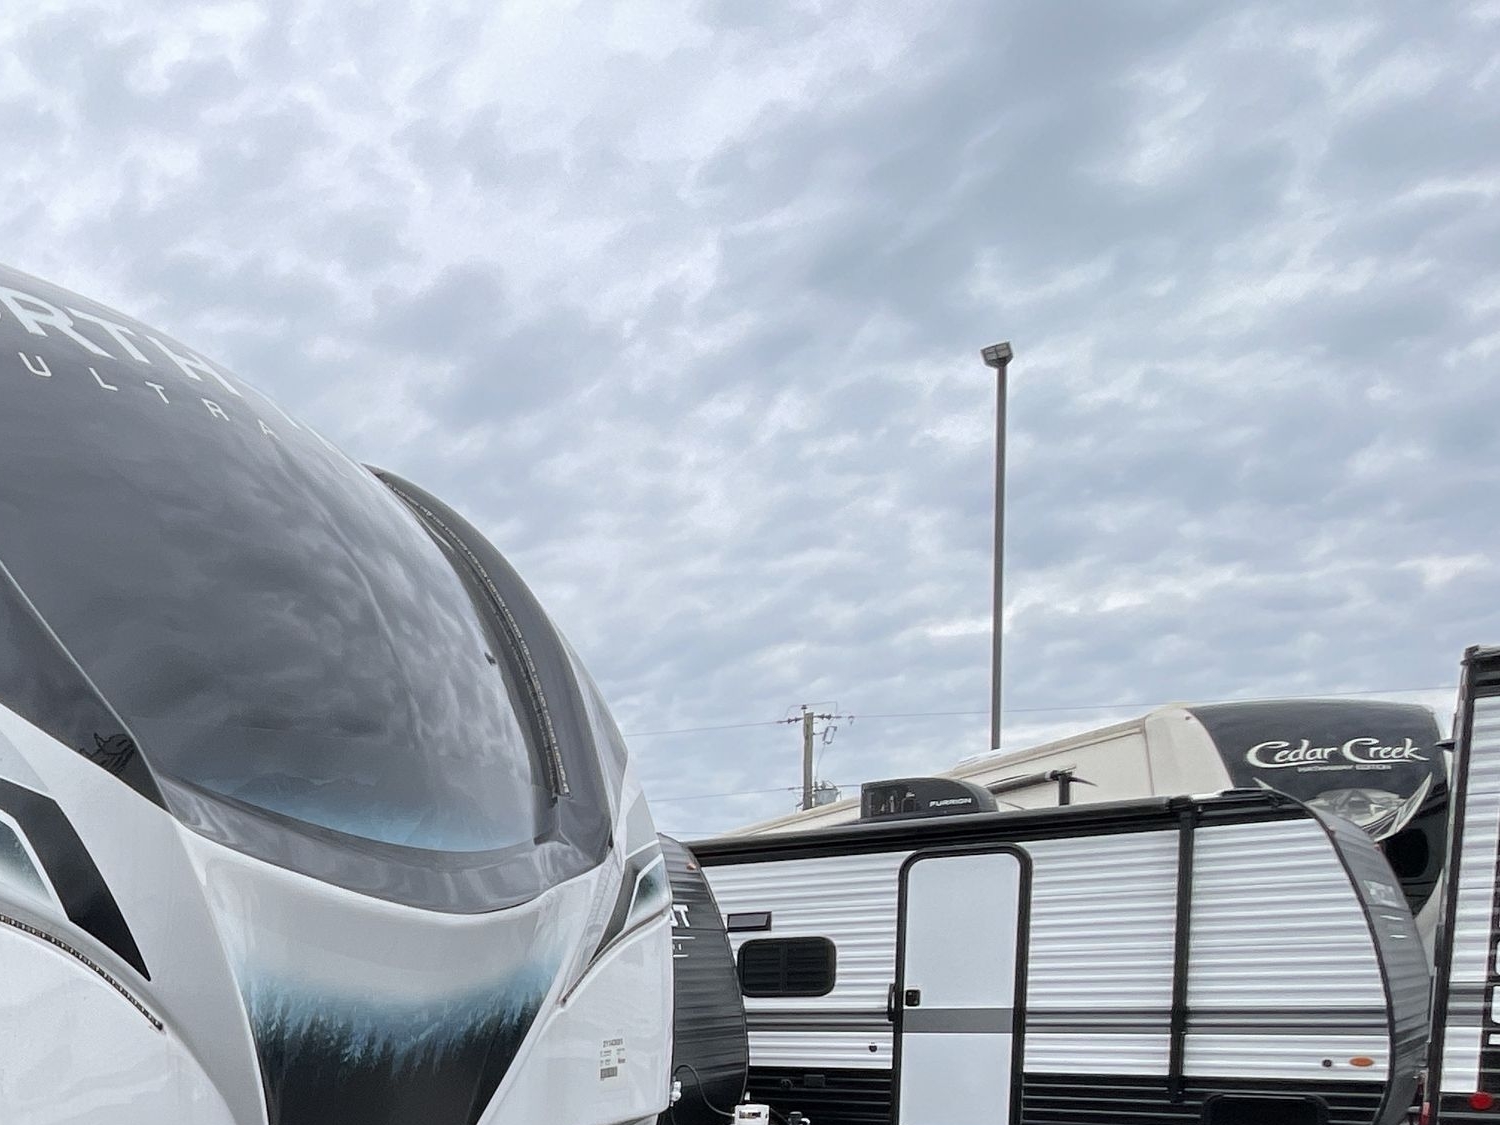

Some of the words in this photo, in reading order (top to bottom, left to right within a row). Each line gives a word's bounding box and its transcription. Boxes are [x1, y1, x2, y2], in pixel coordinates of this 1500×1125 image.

[18, 351, 280, 441] ULTRA
[1246, 739, 1338, 769] Cedar
[1342, 737, 1431, 764] Creek
